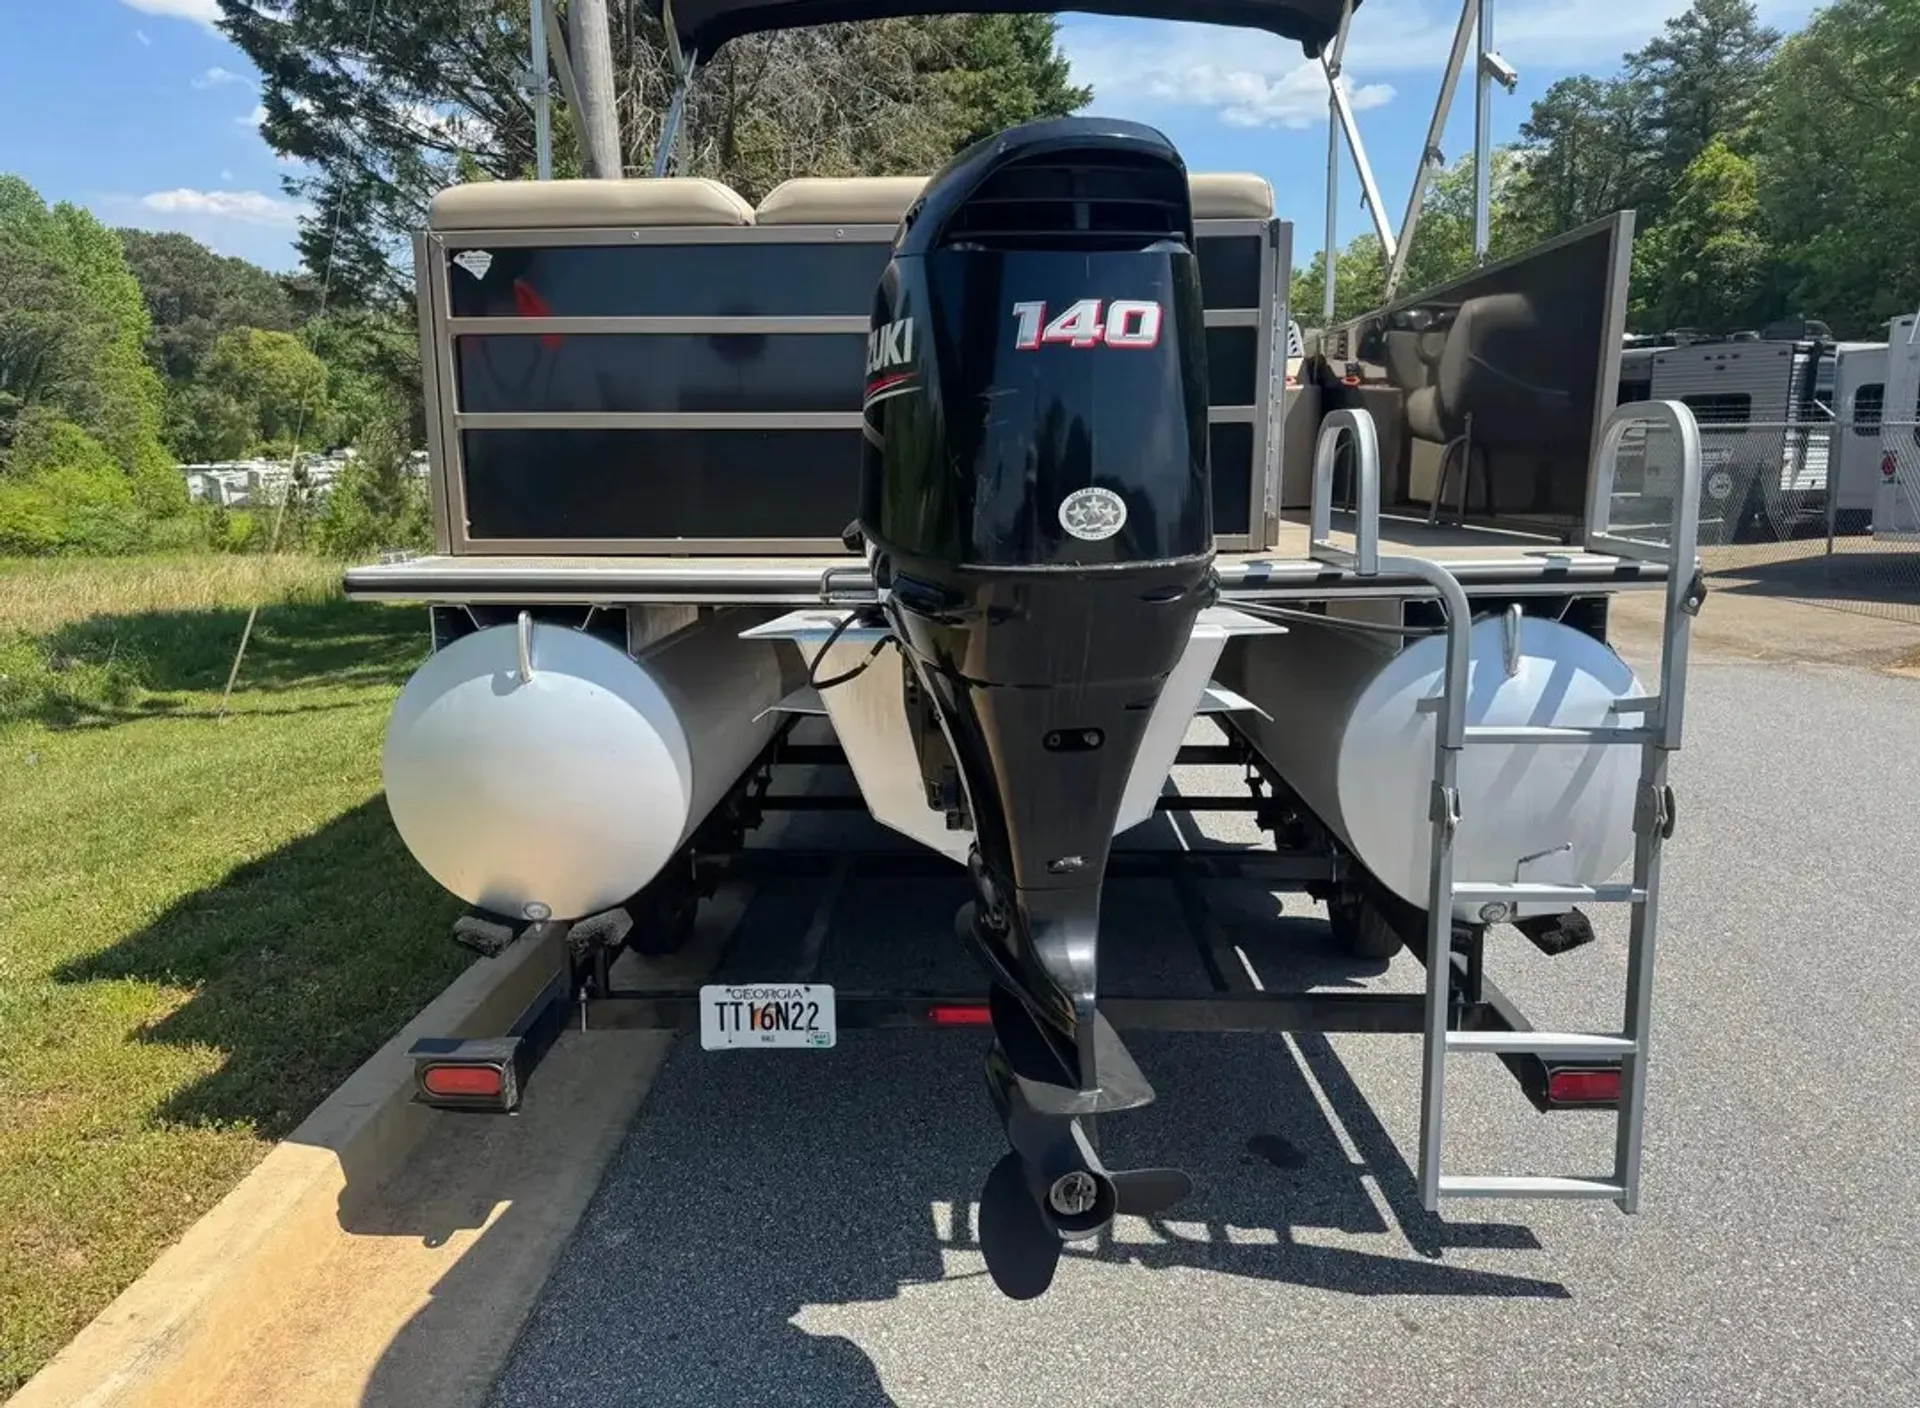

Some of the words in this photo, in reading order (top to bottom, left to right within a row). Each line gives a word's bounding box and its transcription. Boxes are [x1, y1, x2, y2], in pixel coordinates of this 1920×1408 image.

[1012, 298, 1162, 351] 140
[730, 988, 803, 1000] GEORGIA
[714, 1001, 820, 1032] TT16N22
